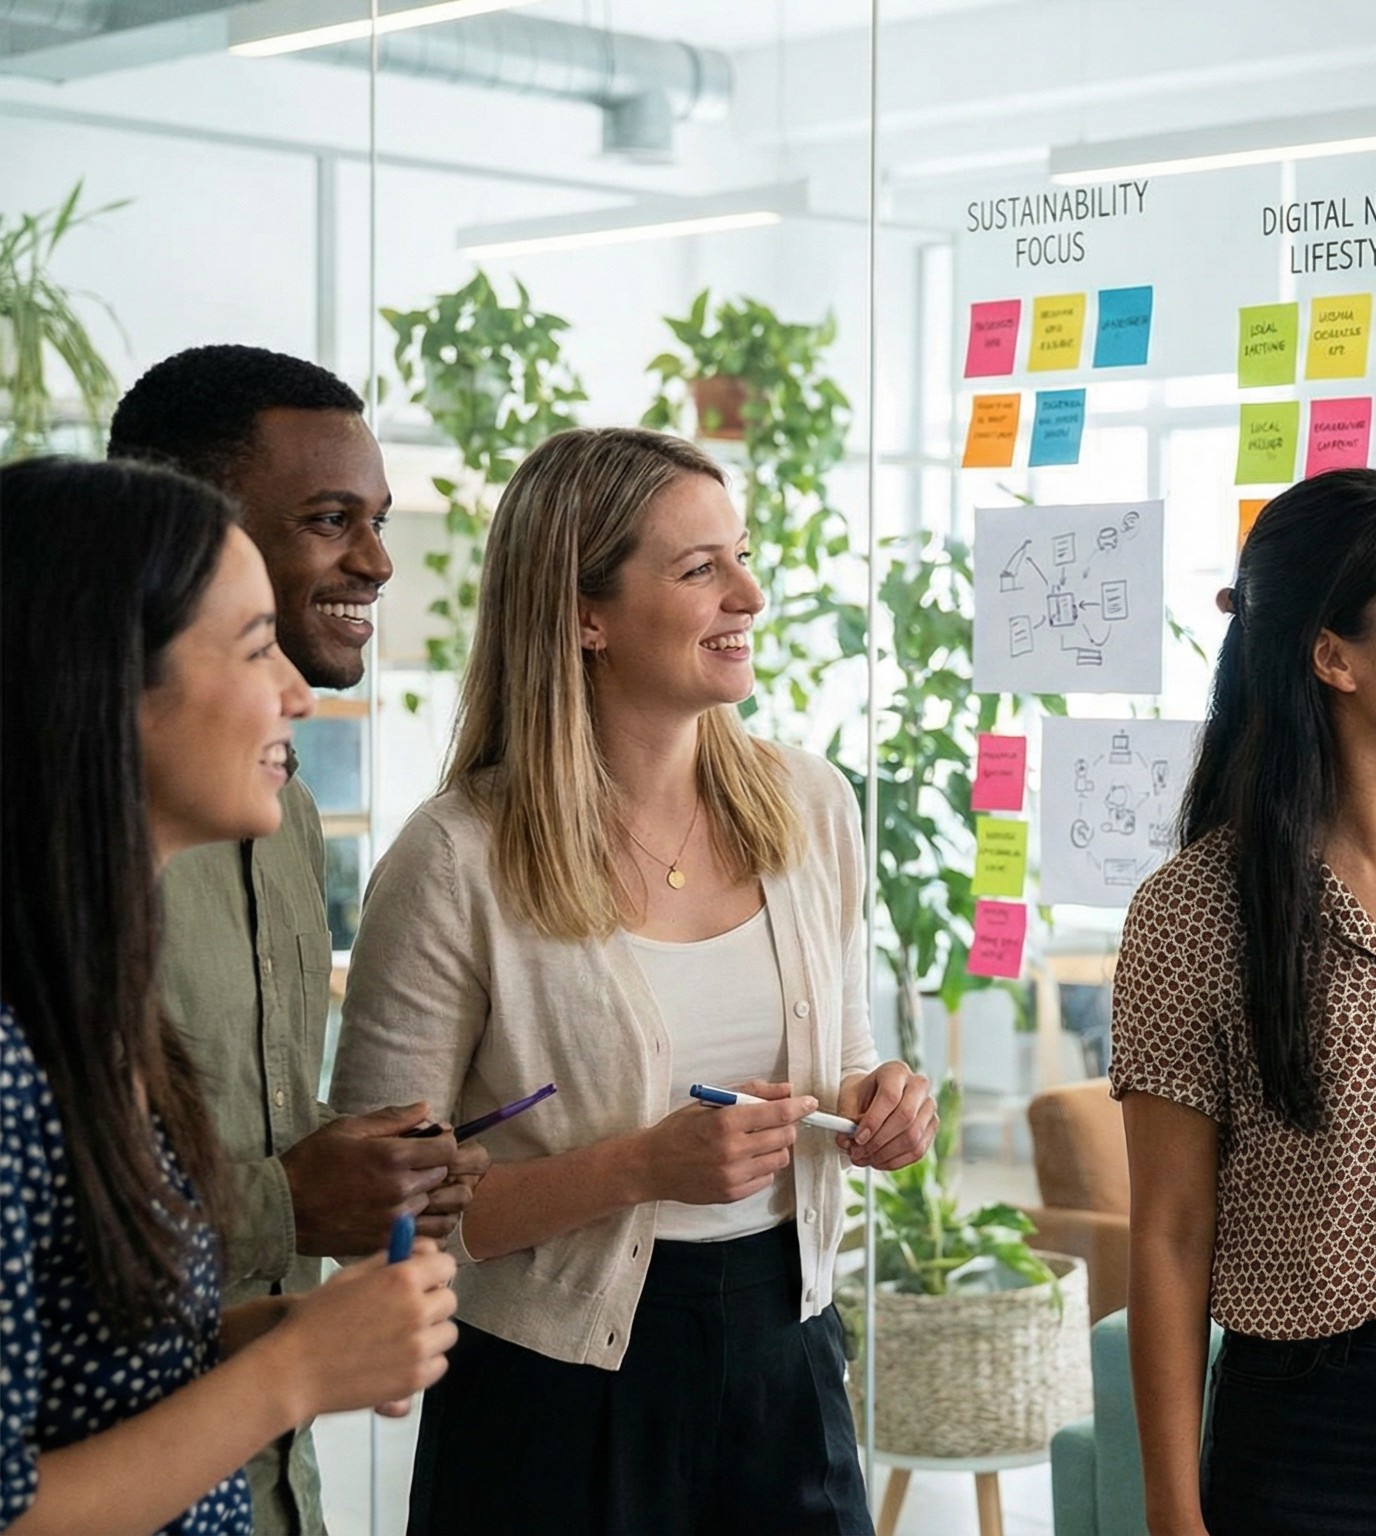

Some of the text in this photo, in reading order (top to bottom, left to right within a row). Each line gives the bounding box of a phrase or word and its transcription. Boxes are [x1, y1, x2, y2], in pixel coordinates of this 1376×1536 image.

[967, 180, 1149, 232] SUSTAINABILITY
[1262, 197, 1354, 236] DIGITAL
[1016, 231, 1085, 268] FOCUS
